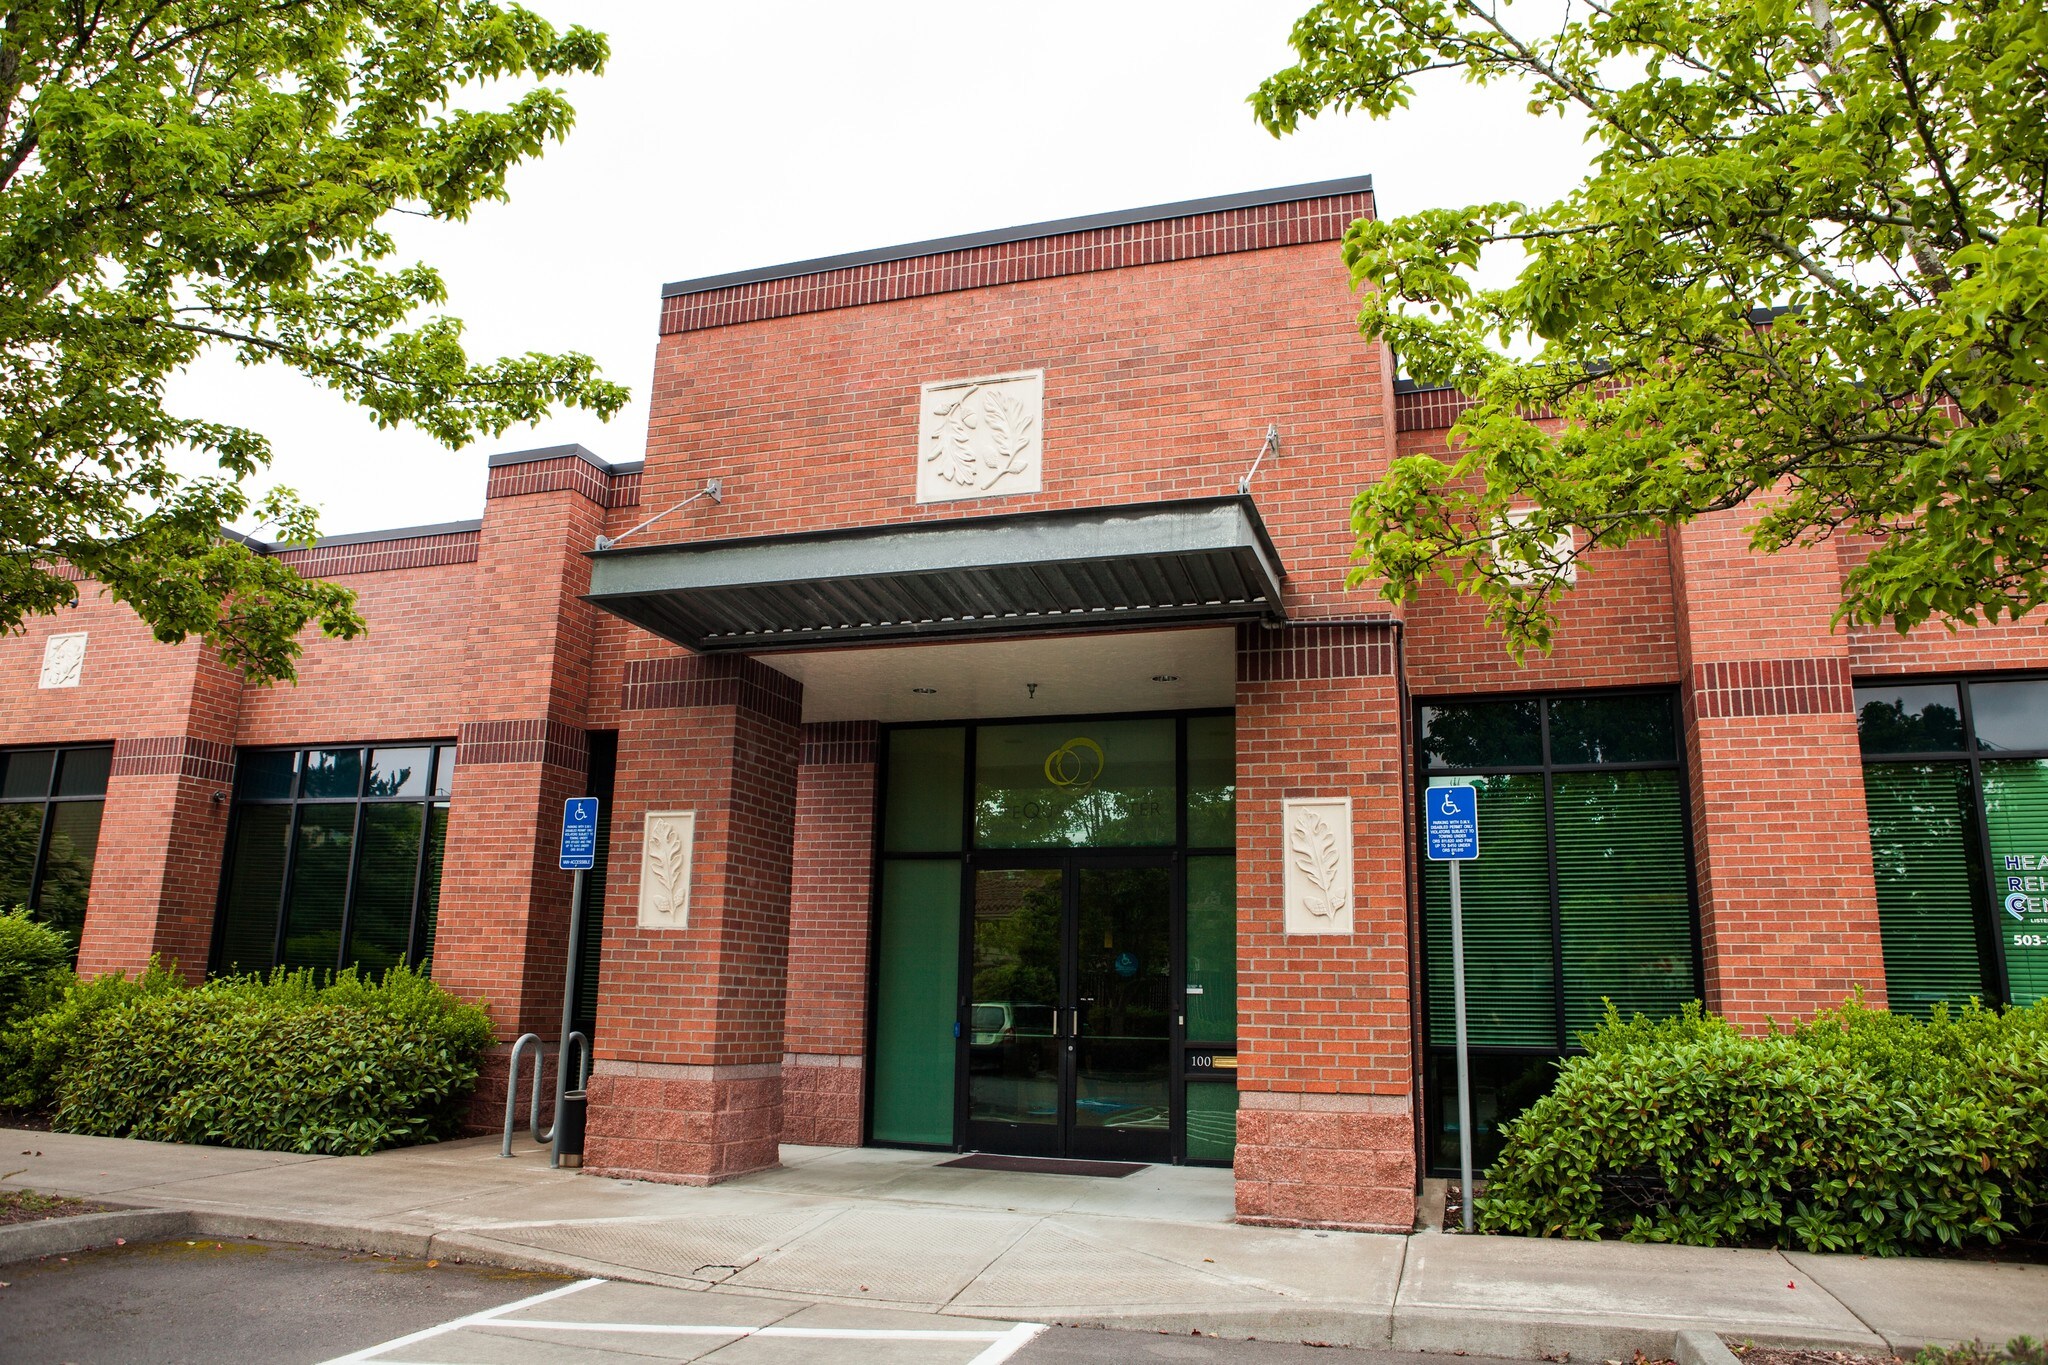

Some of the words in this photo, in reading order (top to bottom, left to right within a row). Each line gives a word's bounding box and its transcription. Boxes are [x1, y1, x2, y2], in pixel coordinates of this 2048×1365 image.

[2004, 855, 2048, 870] HEA
[2014, 934, 2048, 946] 503-
[1191, 1056, 1211, 1067] 100
